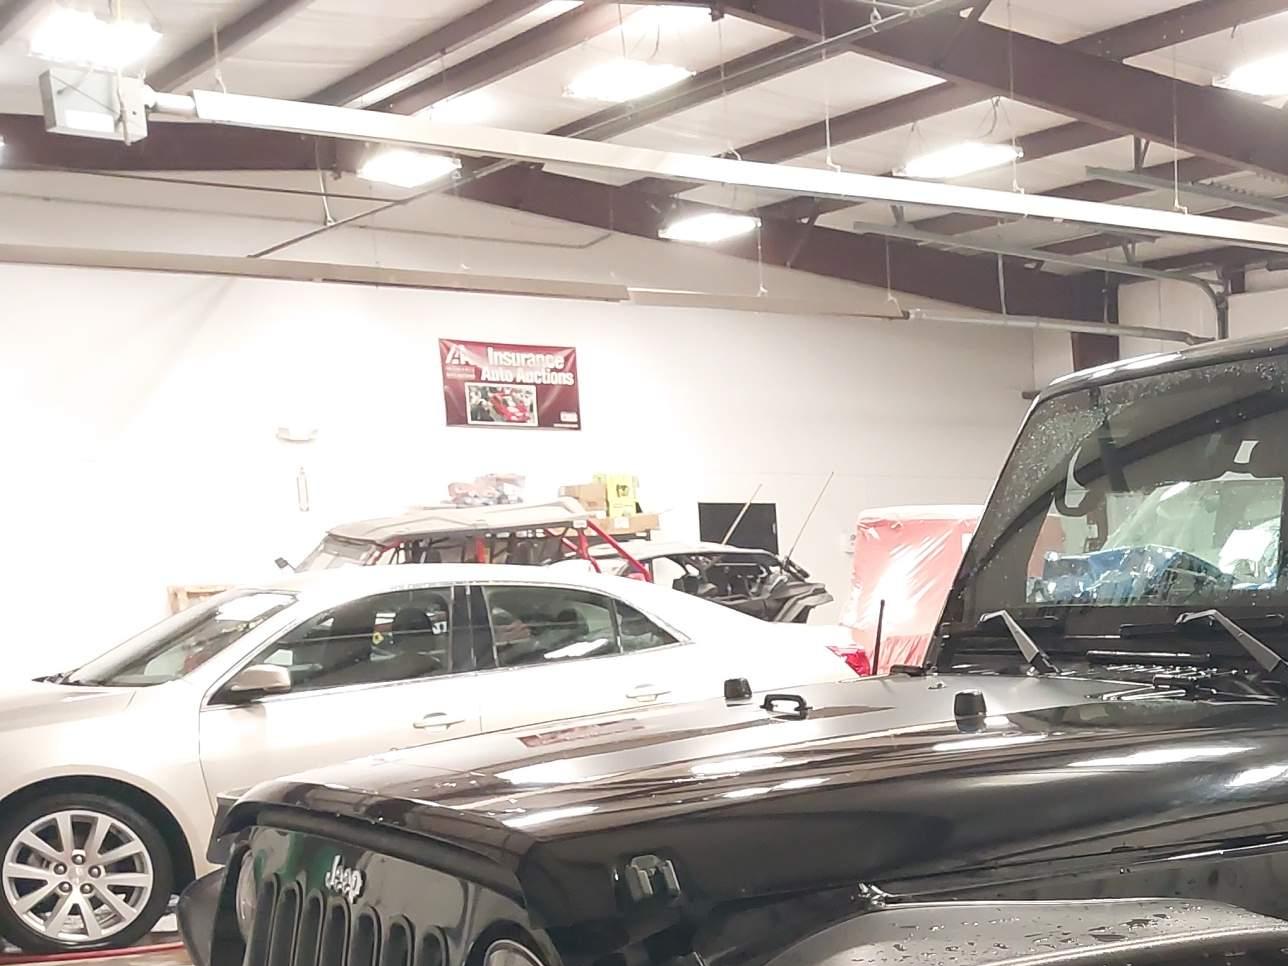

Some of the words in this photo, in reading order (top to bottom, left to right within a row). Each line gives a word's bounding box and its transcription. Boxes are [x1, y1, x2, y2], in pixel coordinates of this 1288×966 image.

[487, 346, 565, 369] Insurance
[480, 367, 514, 384] Auto
[516, 368, 574, 386] Auctions
[325, 855, 363, 904] Jeep
